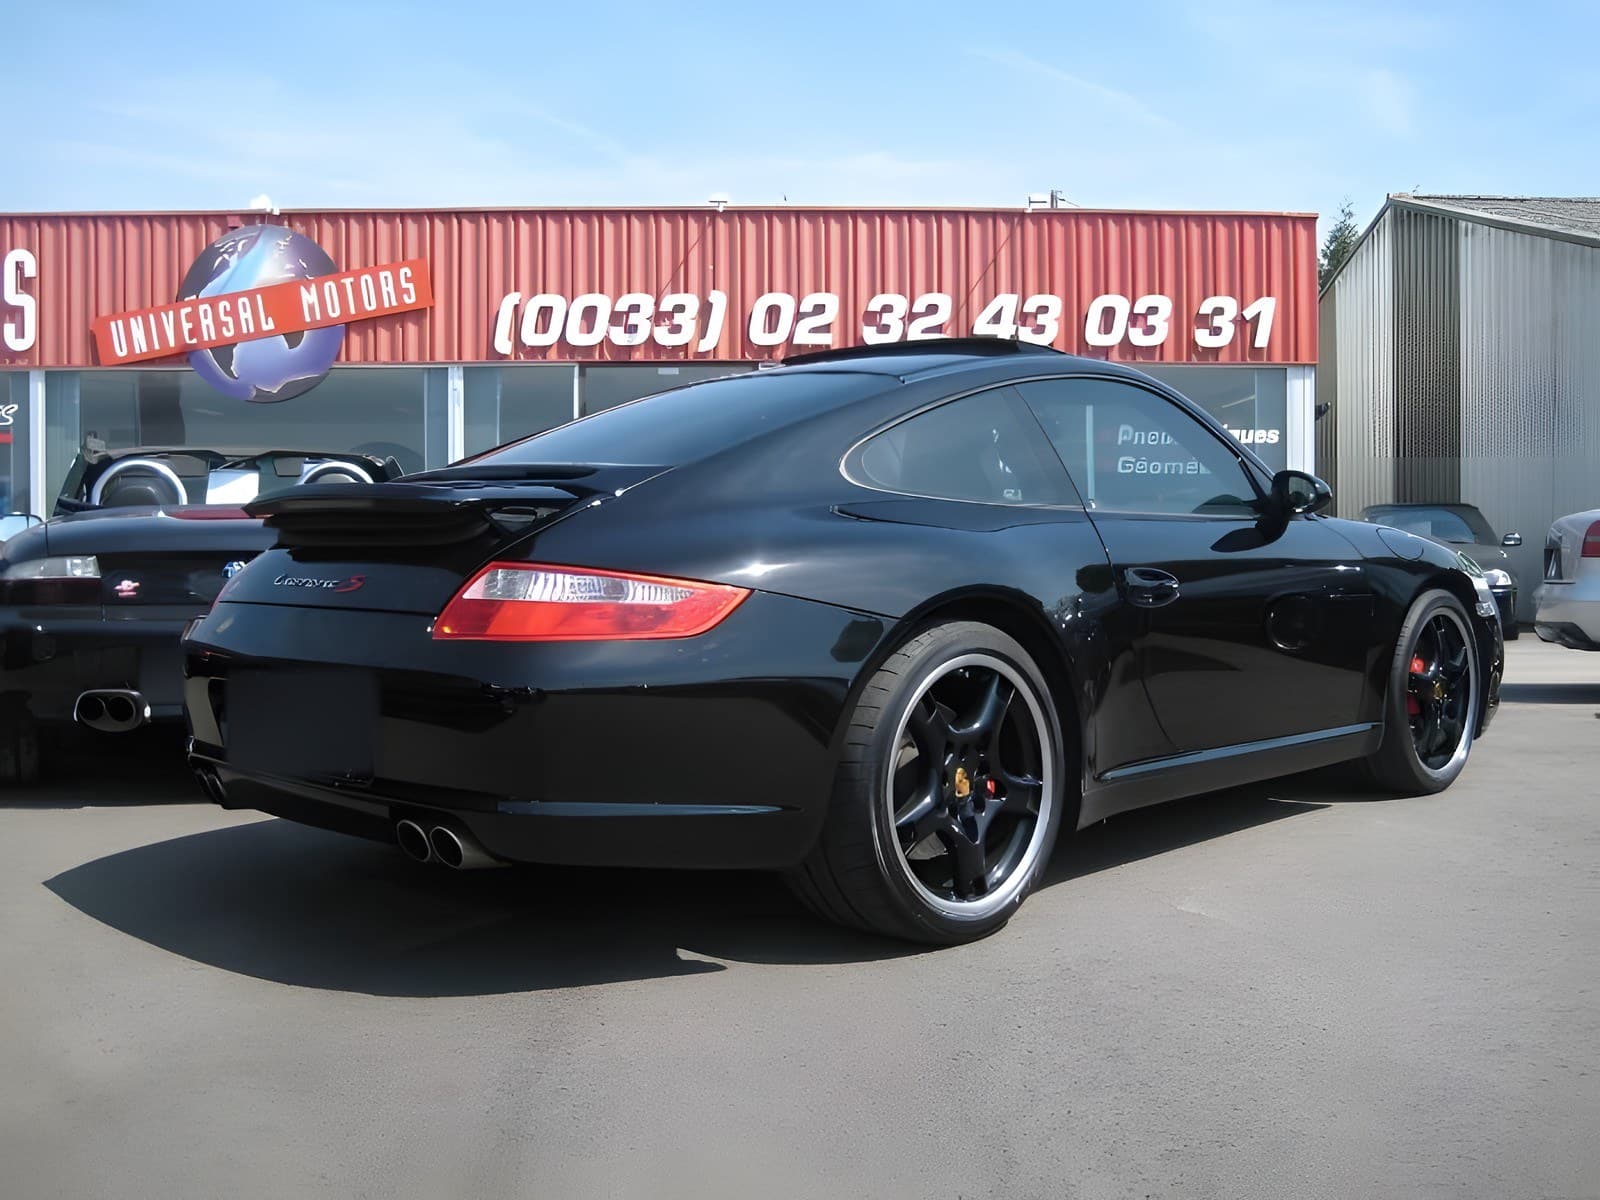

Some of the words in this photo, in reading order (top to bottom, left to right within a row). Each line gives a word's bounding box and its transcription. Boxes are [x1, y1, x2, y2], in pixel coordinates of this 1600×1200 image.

[3, 249, 37, 352] S
[110, 298, 275, 358] UNIVERSAL
[300, 267, 417, 322] MOTORS
[494, 290, 727, 354] (0033)
[749, 292, 839, 346] 02
[862, 293, 952, 345] 32
[973, 293, 1063, 346] 43
[1085, 294, 1173, 347] 03
[1195, 296, 1276, 348] 31
[1222, 423, 1280, 444] ues
